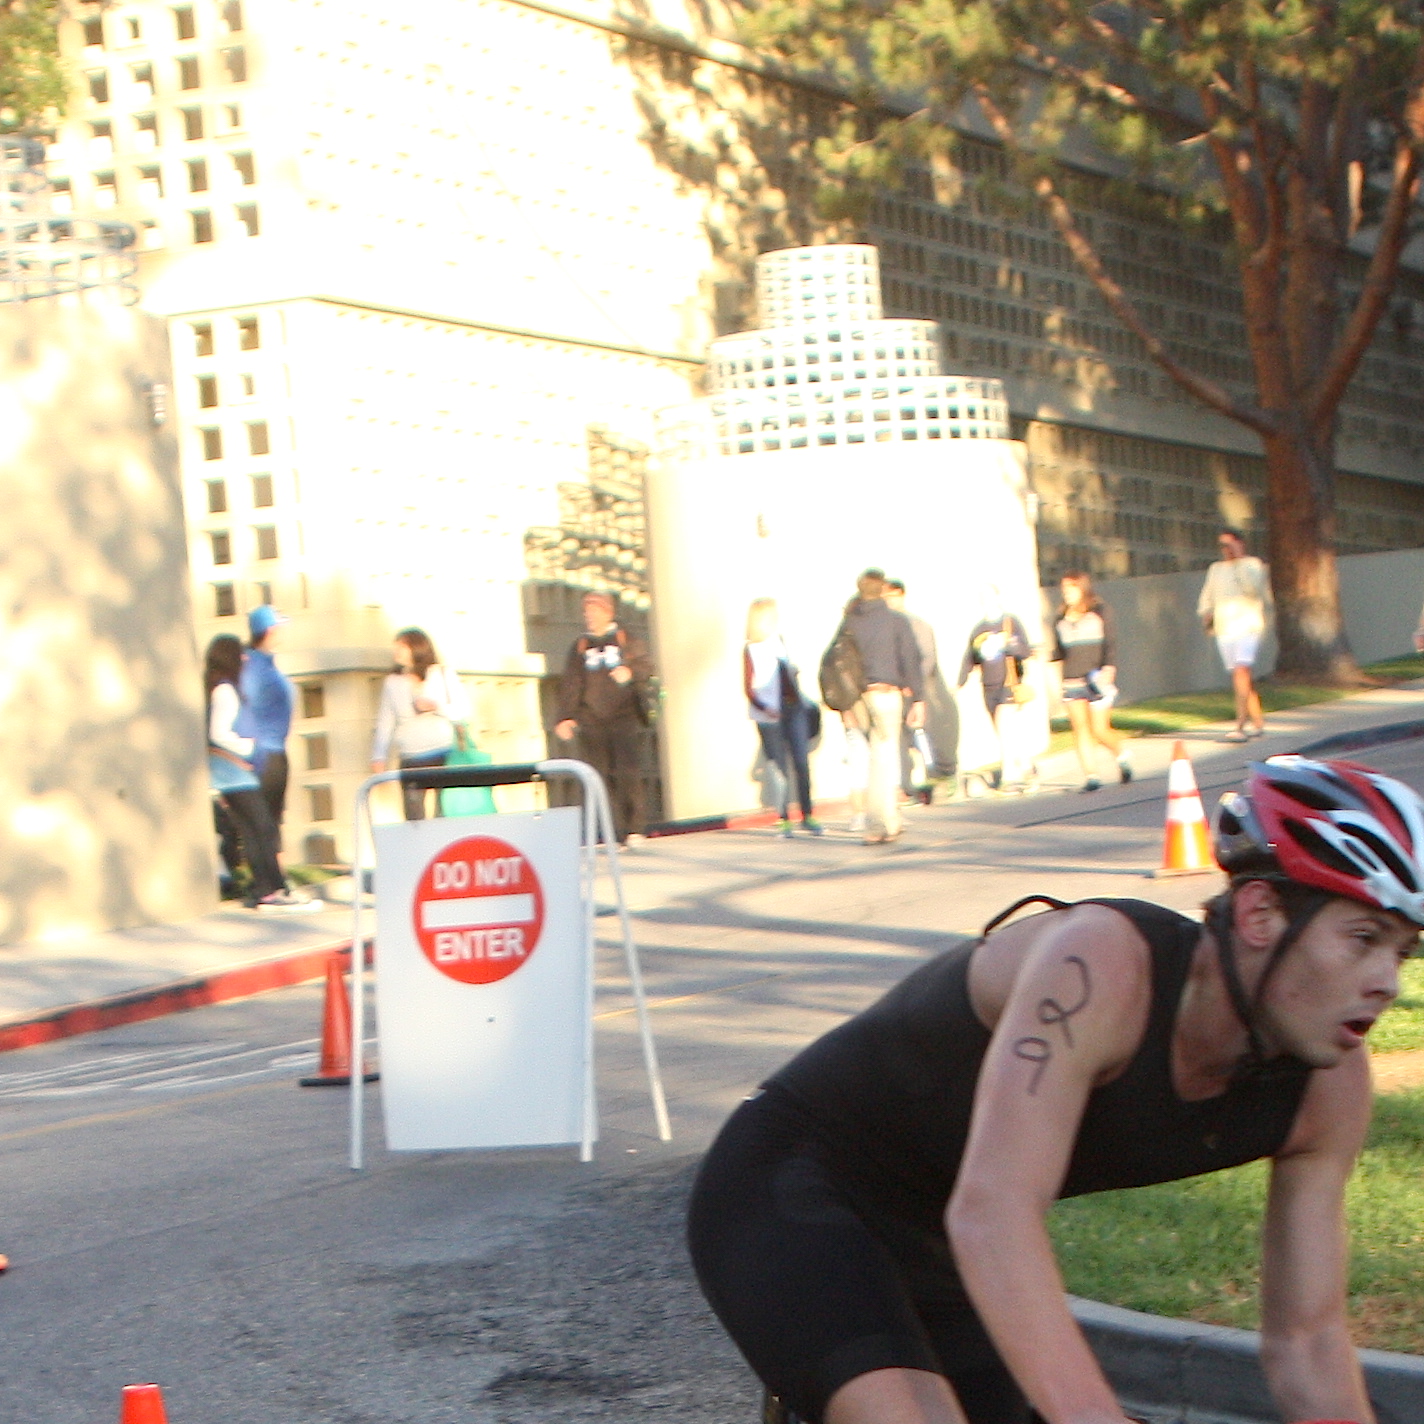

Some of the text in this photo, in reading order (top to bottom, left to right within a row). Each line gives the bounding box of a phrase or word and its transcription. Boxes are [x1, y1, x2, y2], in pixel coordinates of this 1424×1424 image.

[433, 856, 524, 890] DO NOT
[434, 928, 525, 962] ENTER
